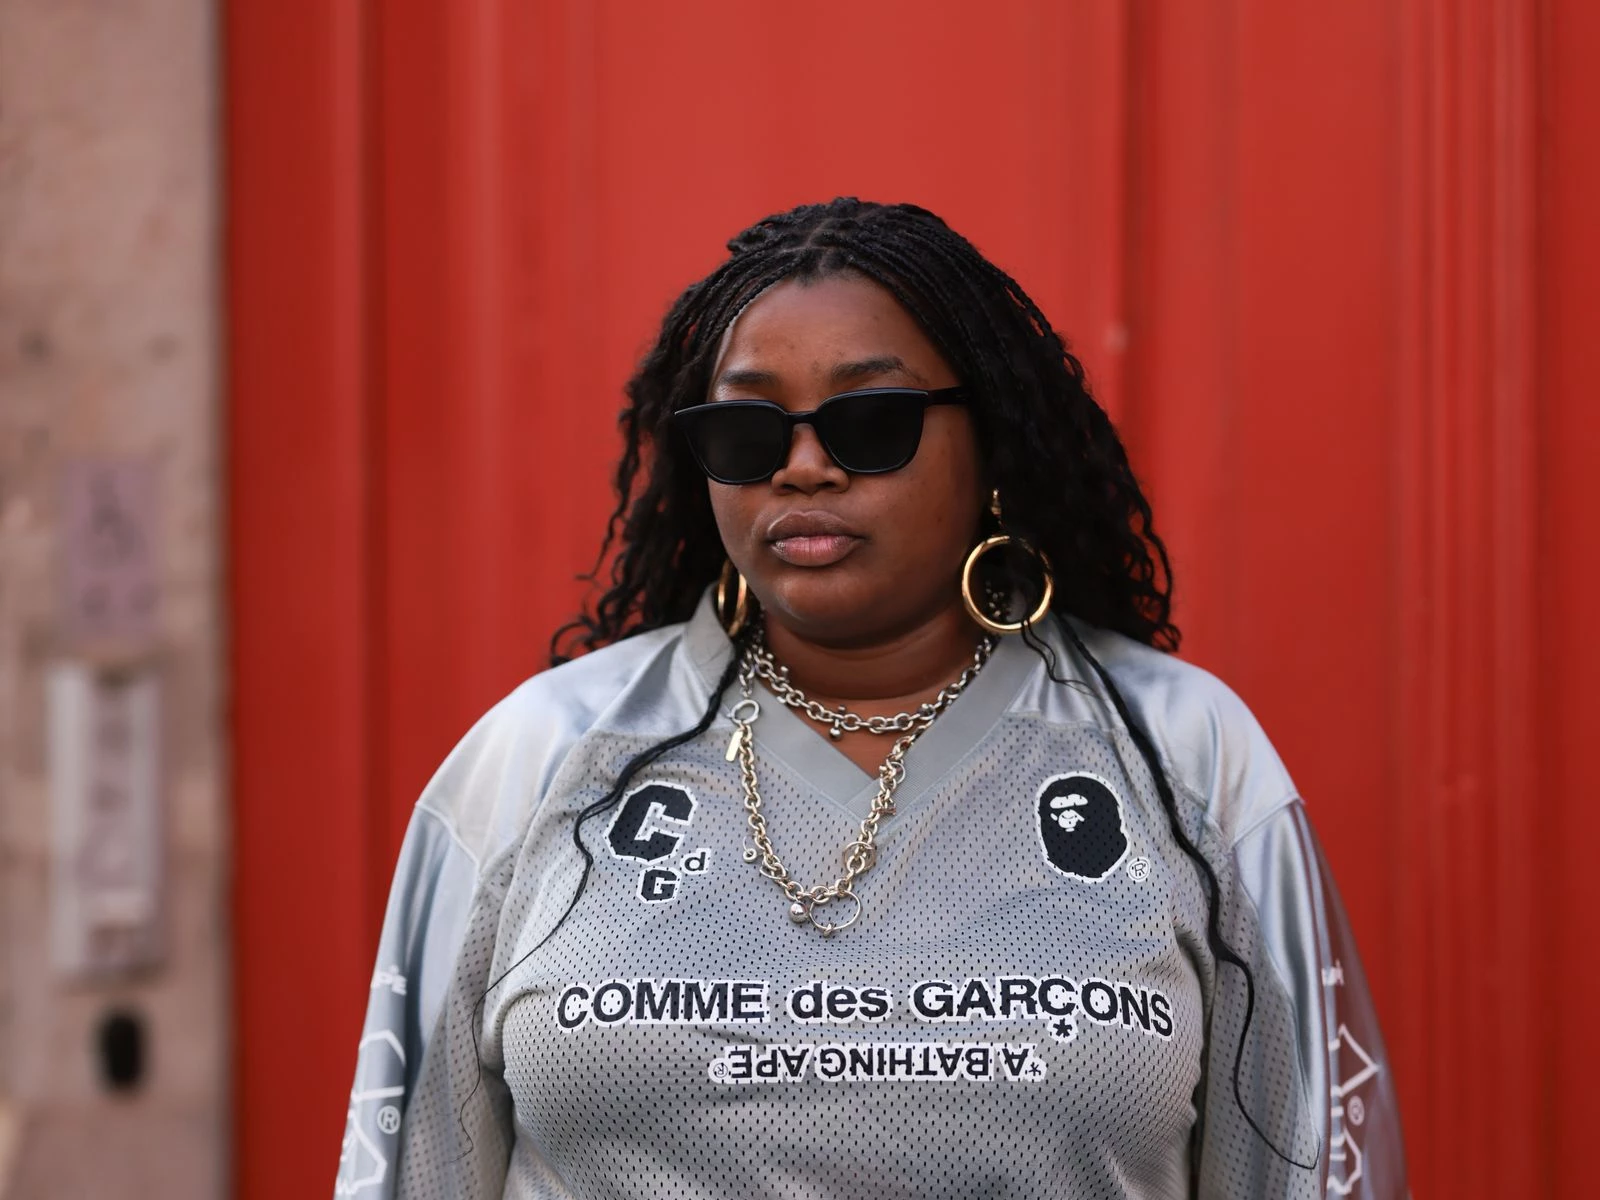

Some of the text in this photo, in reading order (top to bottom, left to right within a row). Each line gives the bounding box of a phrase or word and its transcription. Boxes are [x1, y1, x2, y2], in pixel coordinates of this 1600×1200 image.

[639, 867, 679, 902] G
[557, 980, 766, 1029] COMME
[790, 981, 890, 1021] des
[819, 1046, 991, 1078] BATHING
